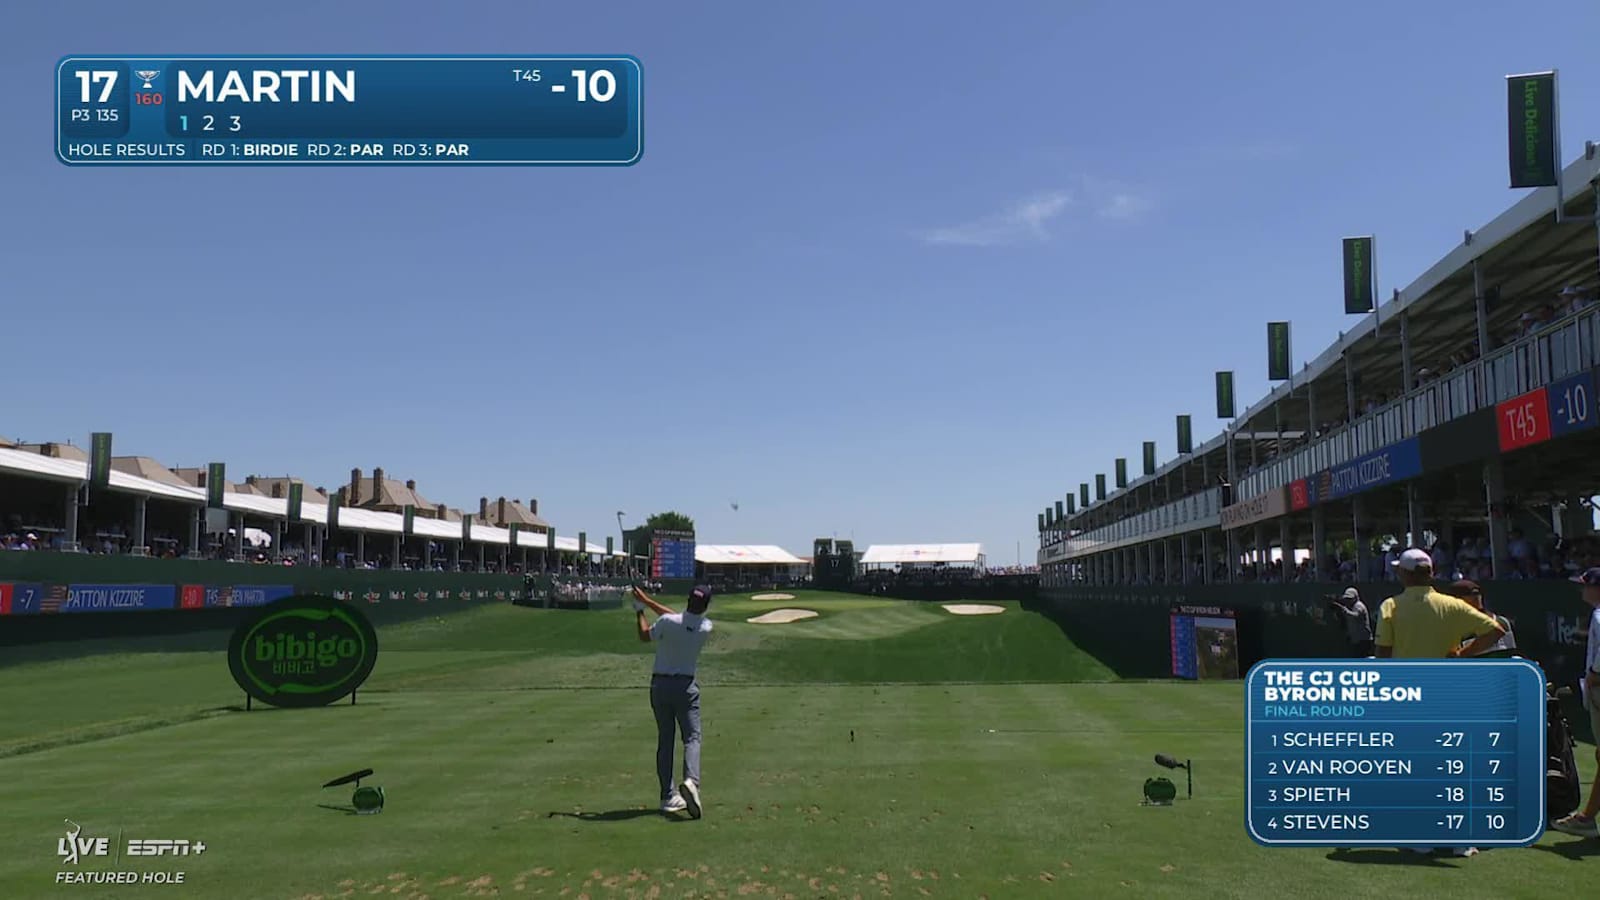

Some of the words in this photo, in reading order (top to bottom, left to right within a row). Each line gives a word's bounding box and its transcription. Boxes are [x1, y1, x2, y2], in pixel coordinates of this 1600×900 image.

[1506, 402, 1536, 441] T45
[1557, 384, 1587, 424] -10
[1330, 466, 1359, 493] PATTON
[1359, 453, 1391, 485] KIZZIRE
[20, 590, 34, 608] -7
[66, 589, 107, 608] PATTON
[109, 589, 144, 608] KIZZIRE
[256, 632, 357, 667] bibigo
[273, 660, 315, 675] 비비고
